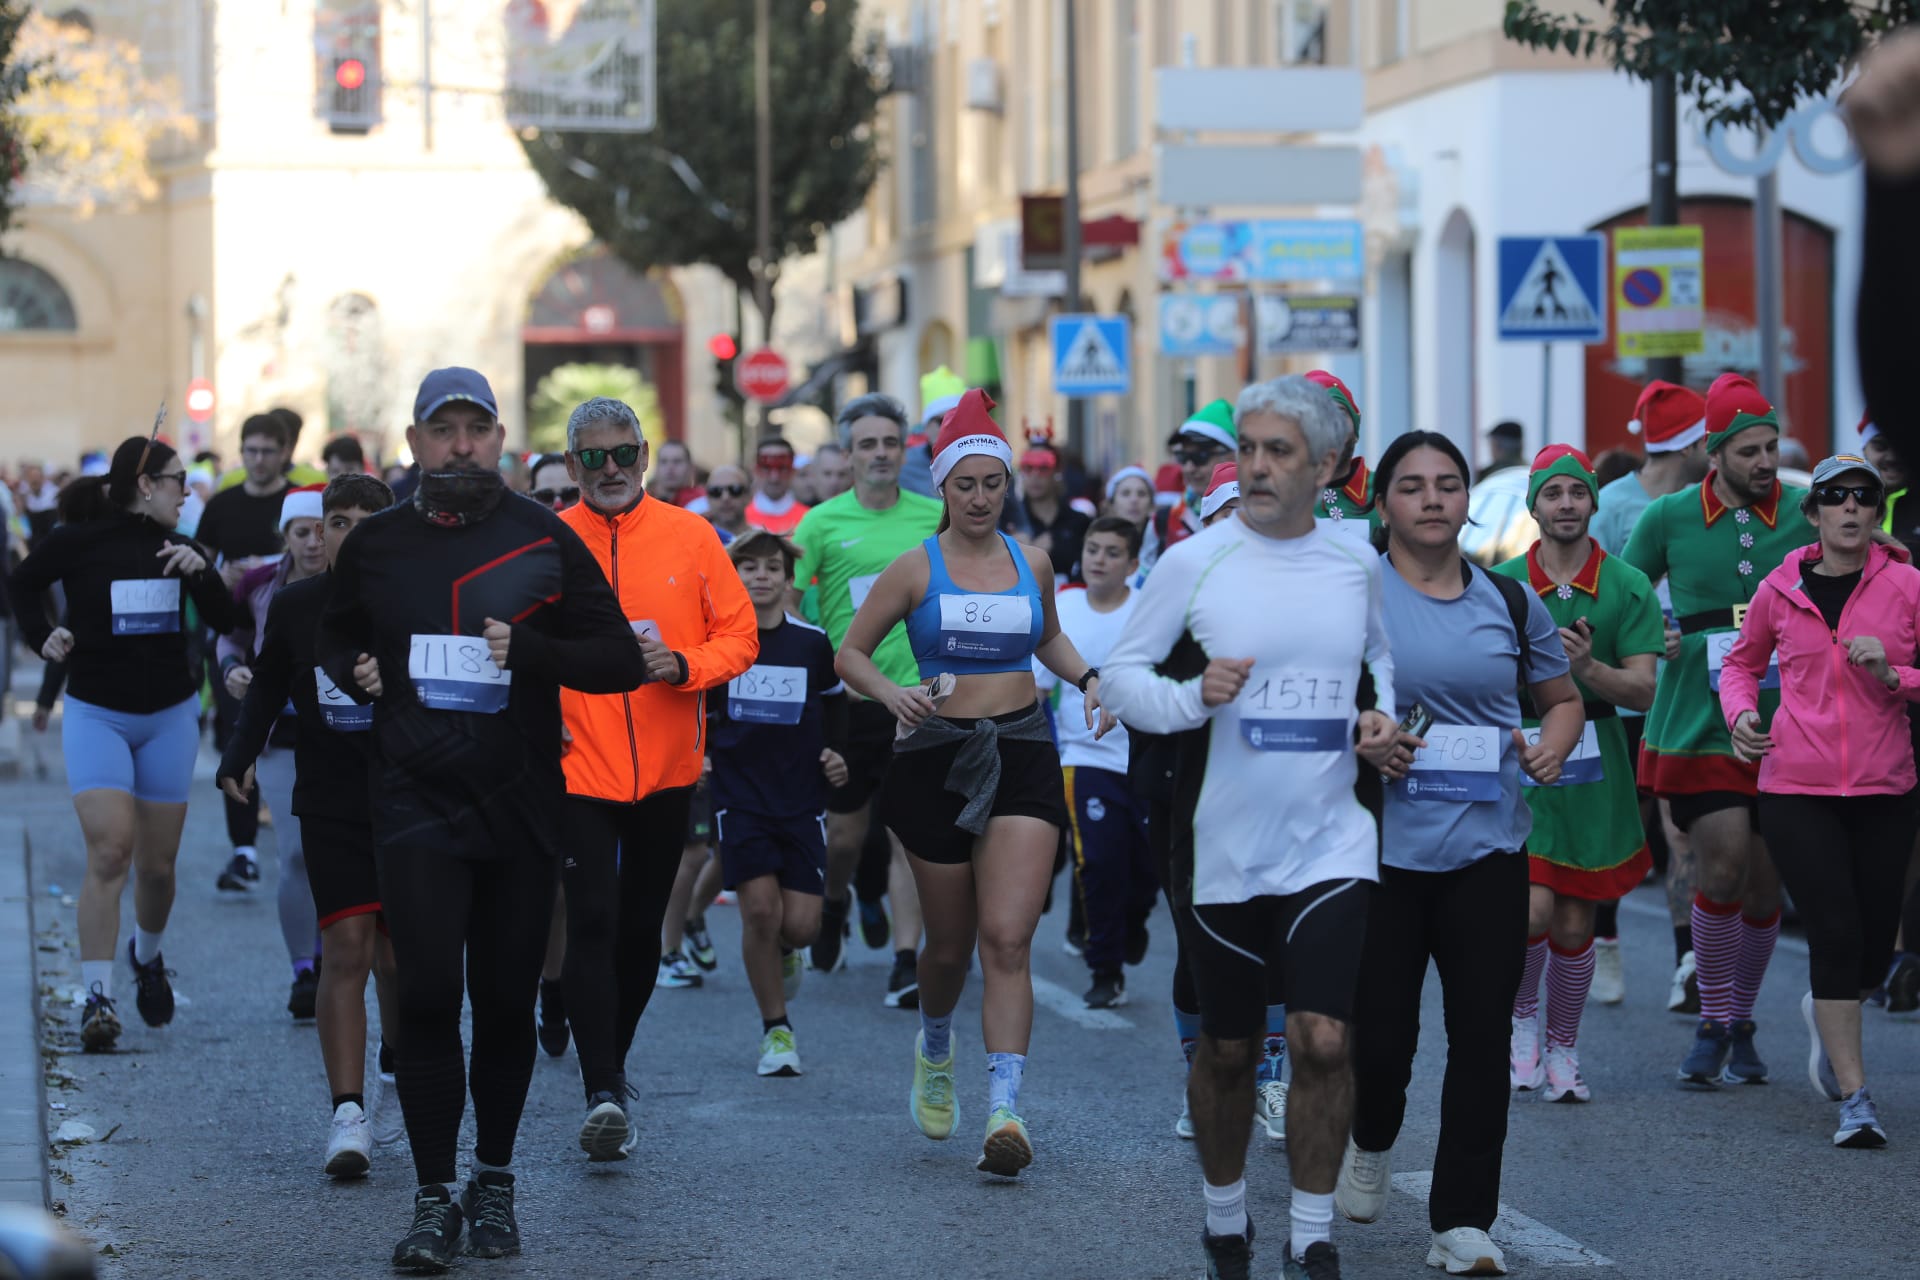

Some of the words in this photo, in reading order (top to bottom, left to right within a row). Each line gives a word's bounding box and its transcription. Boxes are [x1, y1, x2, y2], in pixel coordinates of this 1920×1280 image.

[957, 437, 998, 449] OKEYMAS
[964, 601, 1000, 624] 86
[736, 670, 798, 698] 1855
[1248, 677, 1344, 711] 1577
